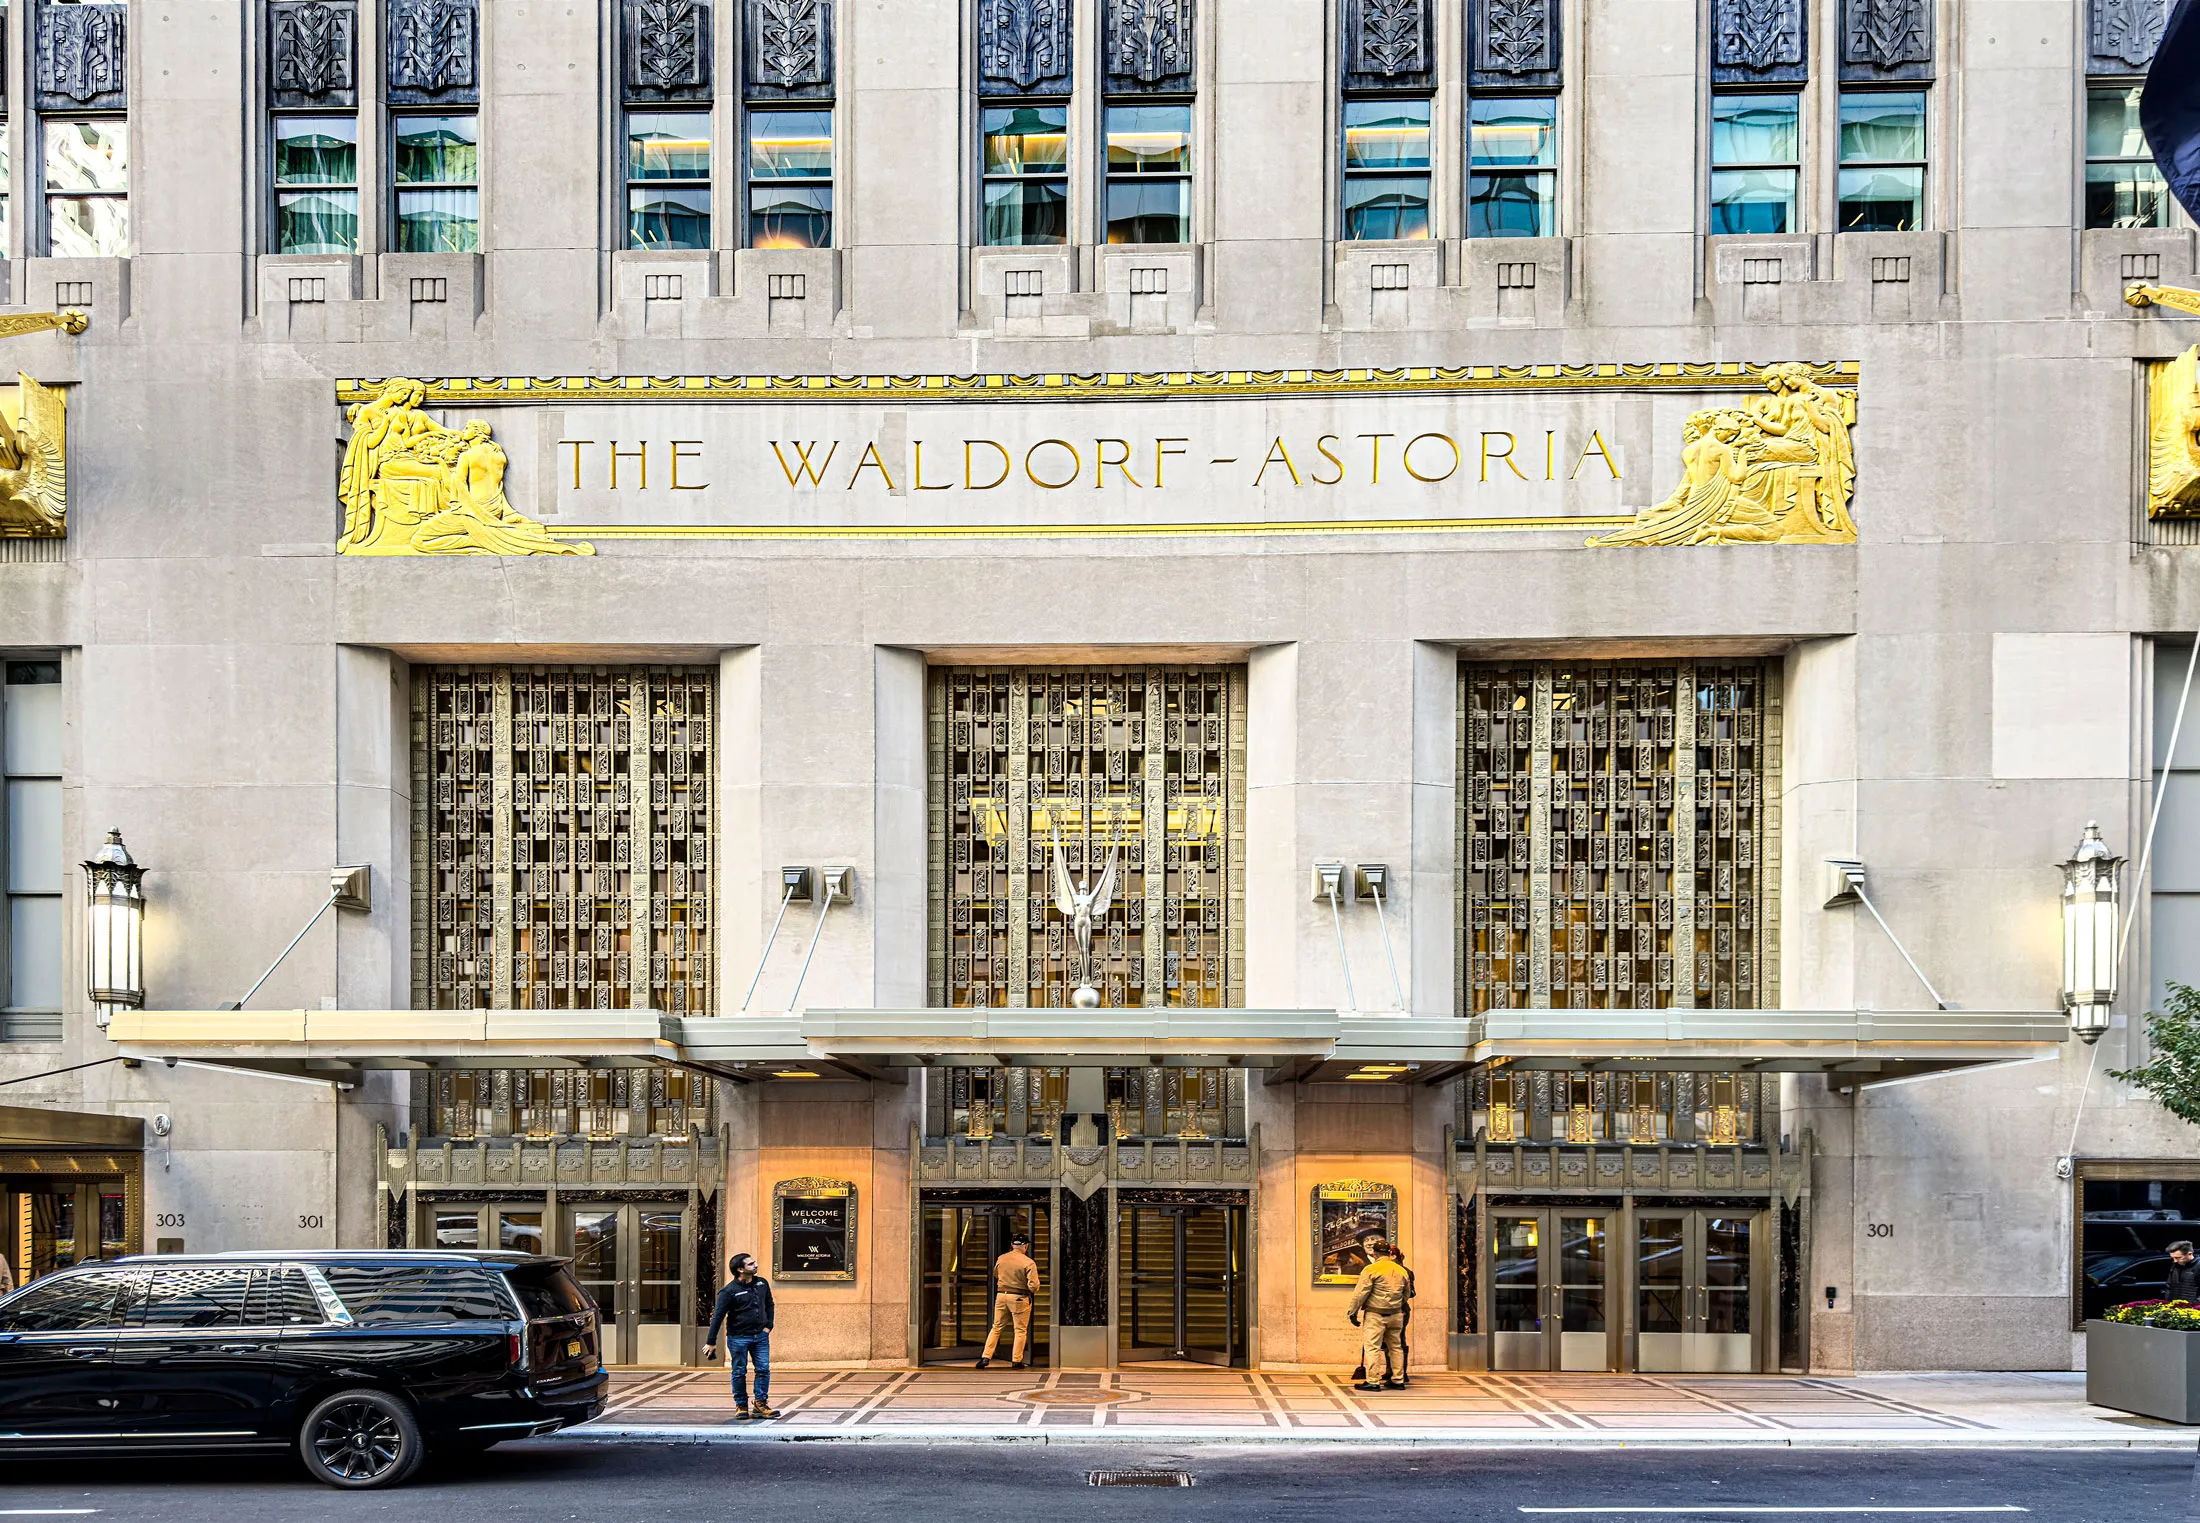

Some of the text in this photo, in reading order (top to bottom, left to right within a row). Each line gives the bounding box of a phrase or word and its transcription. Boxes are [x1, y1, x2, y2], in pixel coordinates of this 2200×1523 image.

[558, 440, 711, 490] THE
[156, 1213, 185, 1227] 303
[298, 1215, 323, 1228] 301
[1867, 1223, 1894, 1237] 301
